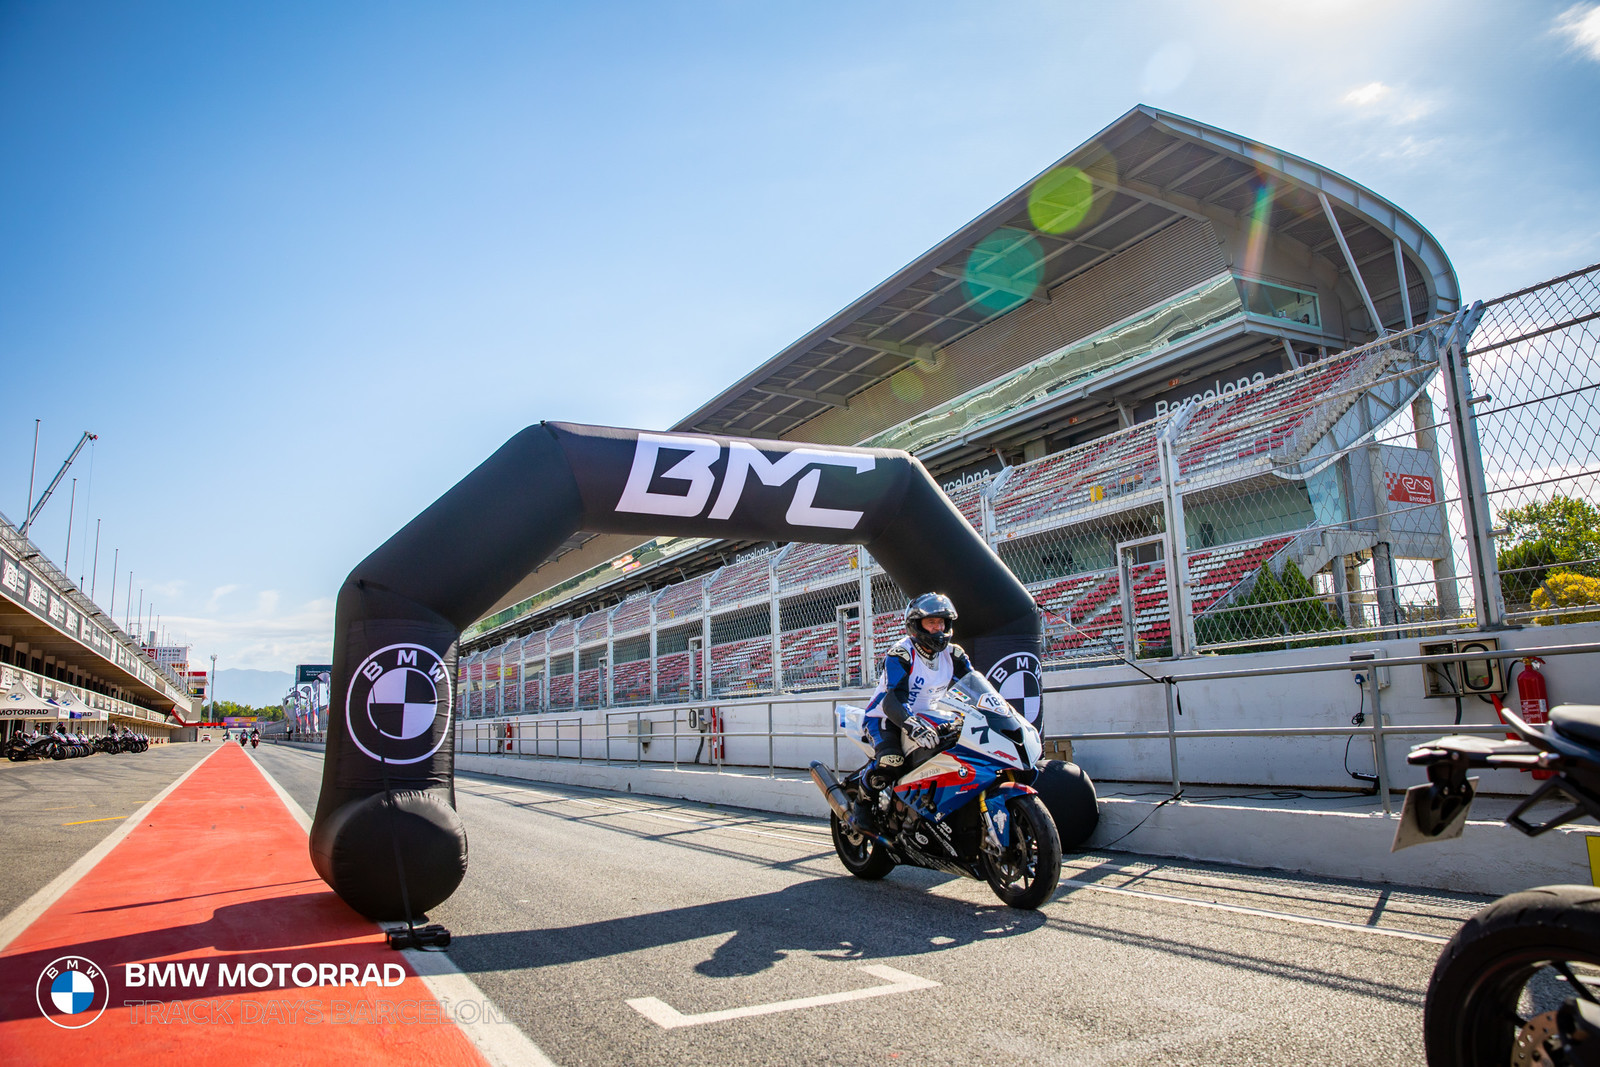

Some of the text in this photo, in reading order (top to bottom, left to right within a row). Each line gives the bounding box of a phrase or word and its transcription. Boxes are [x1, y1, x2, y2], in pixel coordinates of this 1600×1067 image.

[1155, 371, 1267, 417] Barcelona
[615, 433, 876, 530] BMC
[941, 469, 990, 492] rcelona
[362, 650, 446, 683] BMW
[971, 725, 990, 745] 7
